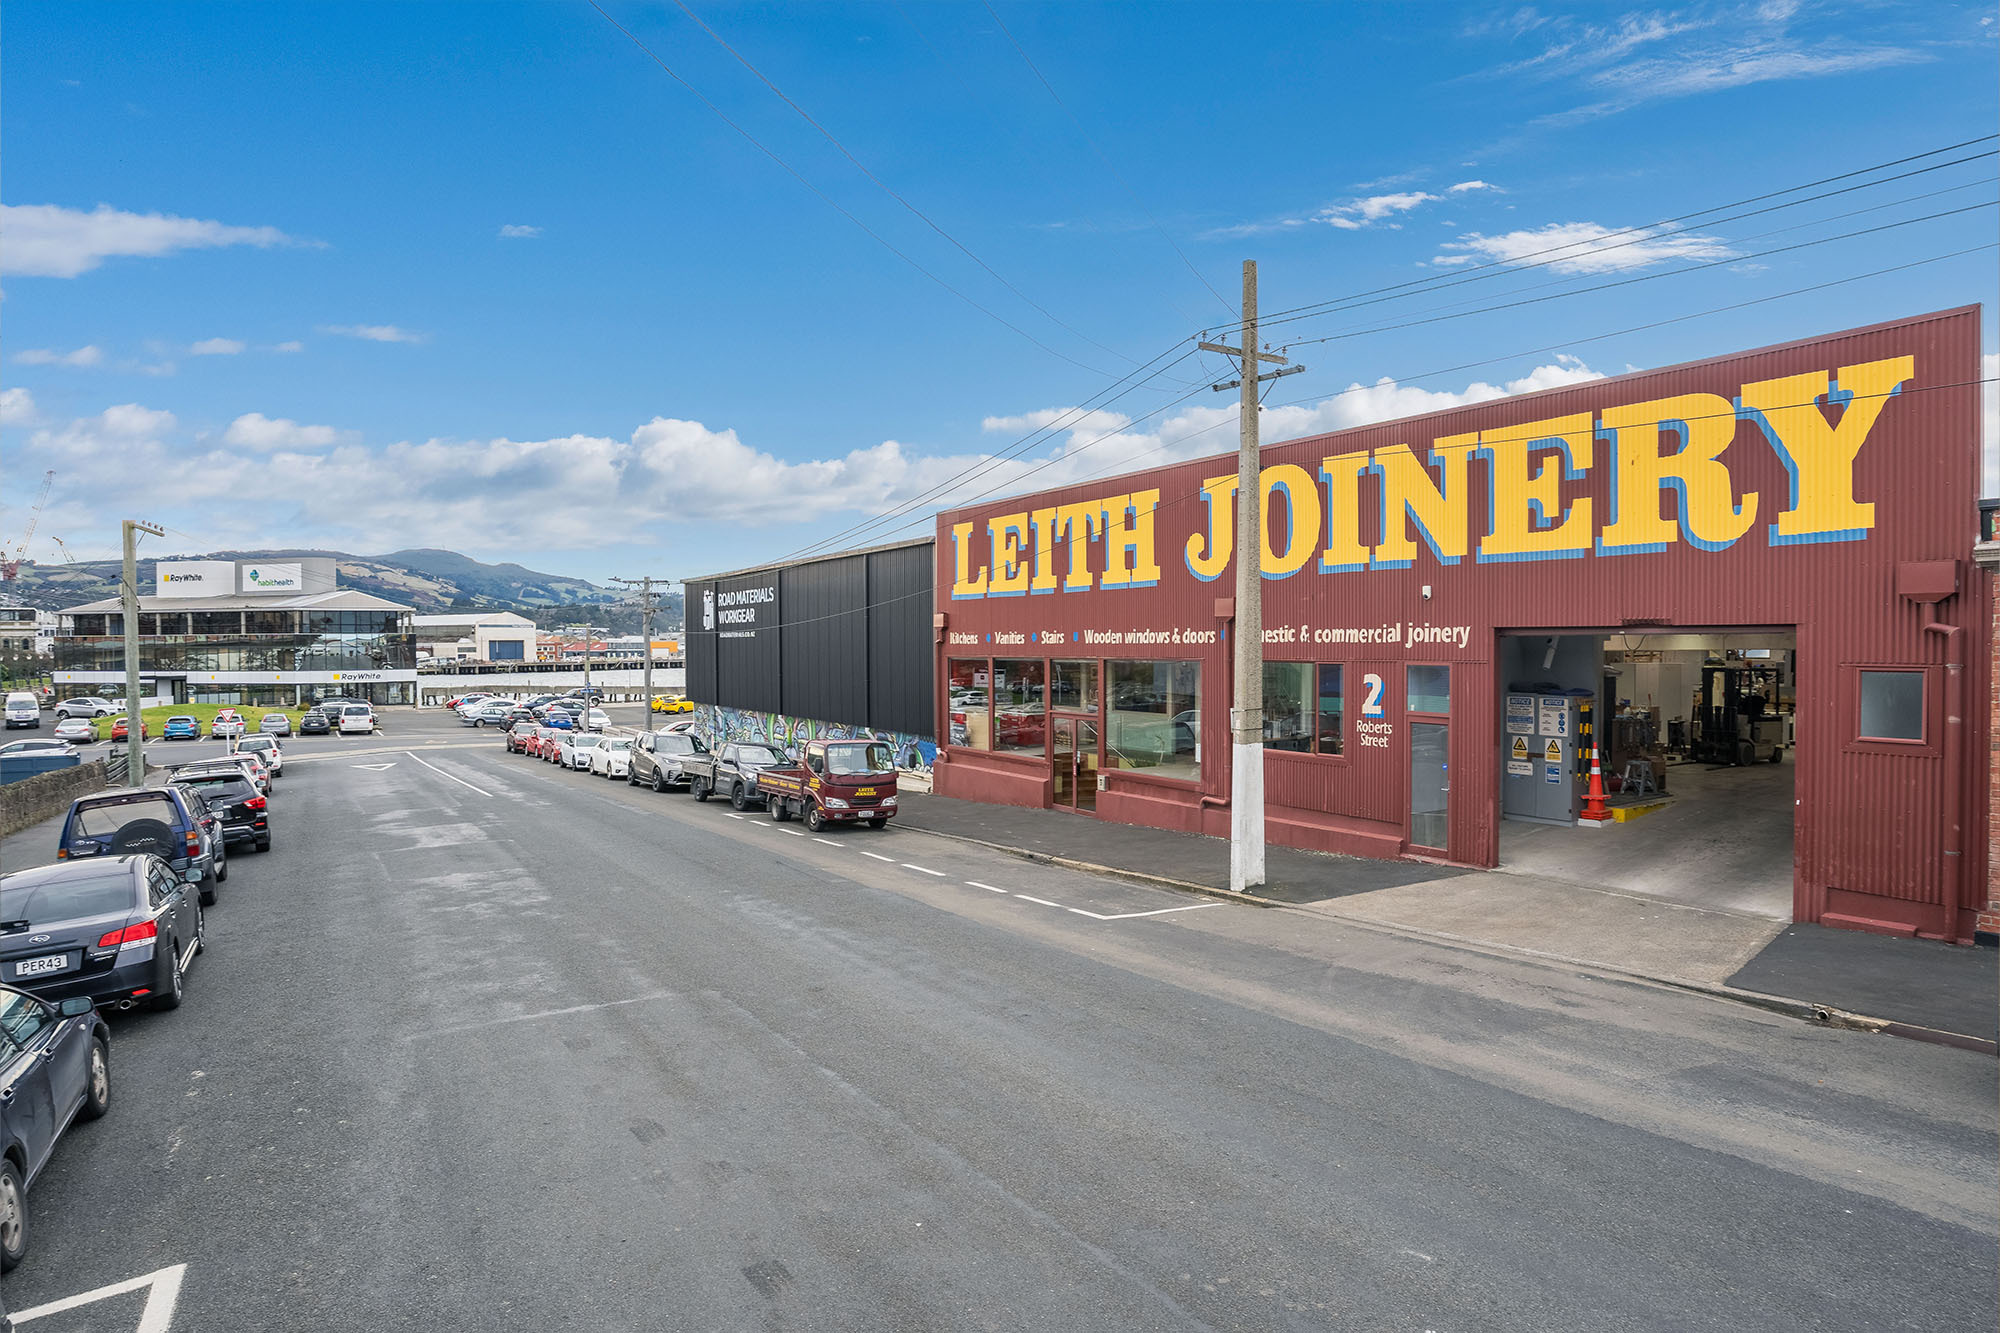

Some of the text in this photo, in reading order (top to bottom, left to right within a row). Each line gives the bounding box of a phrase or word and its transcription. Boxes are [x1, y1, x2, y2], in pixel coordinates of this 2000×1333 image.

[952, 354, 1915, 600] LEITH JOINERY
[718, 586, 774, 607] ROAD MATERIALS
[718, 608, 756, 624] WORKGEAR
[949, 631, 979, 645] Kitchens
[995, 630, 1025, 646] Vanities
[1041, 629, 1066, 645] Stairs
[1084, 627, 1216, 645] Wooden windows & doors
[1299, 624, 1311, 643] &
[1314, 622, 1402, 644] commercial
[1405, 622, 1471, 648] joinery
[1362, 673, 1386, 719] 2
[1356, 720, 1393, 735] Roberts
[1360, 734, 1389, 748] Street
[22, 957, 62, 973] PER43
